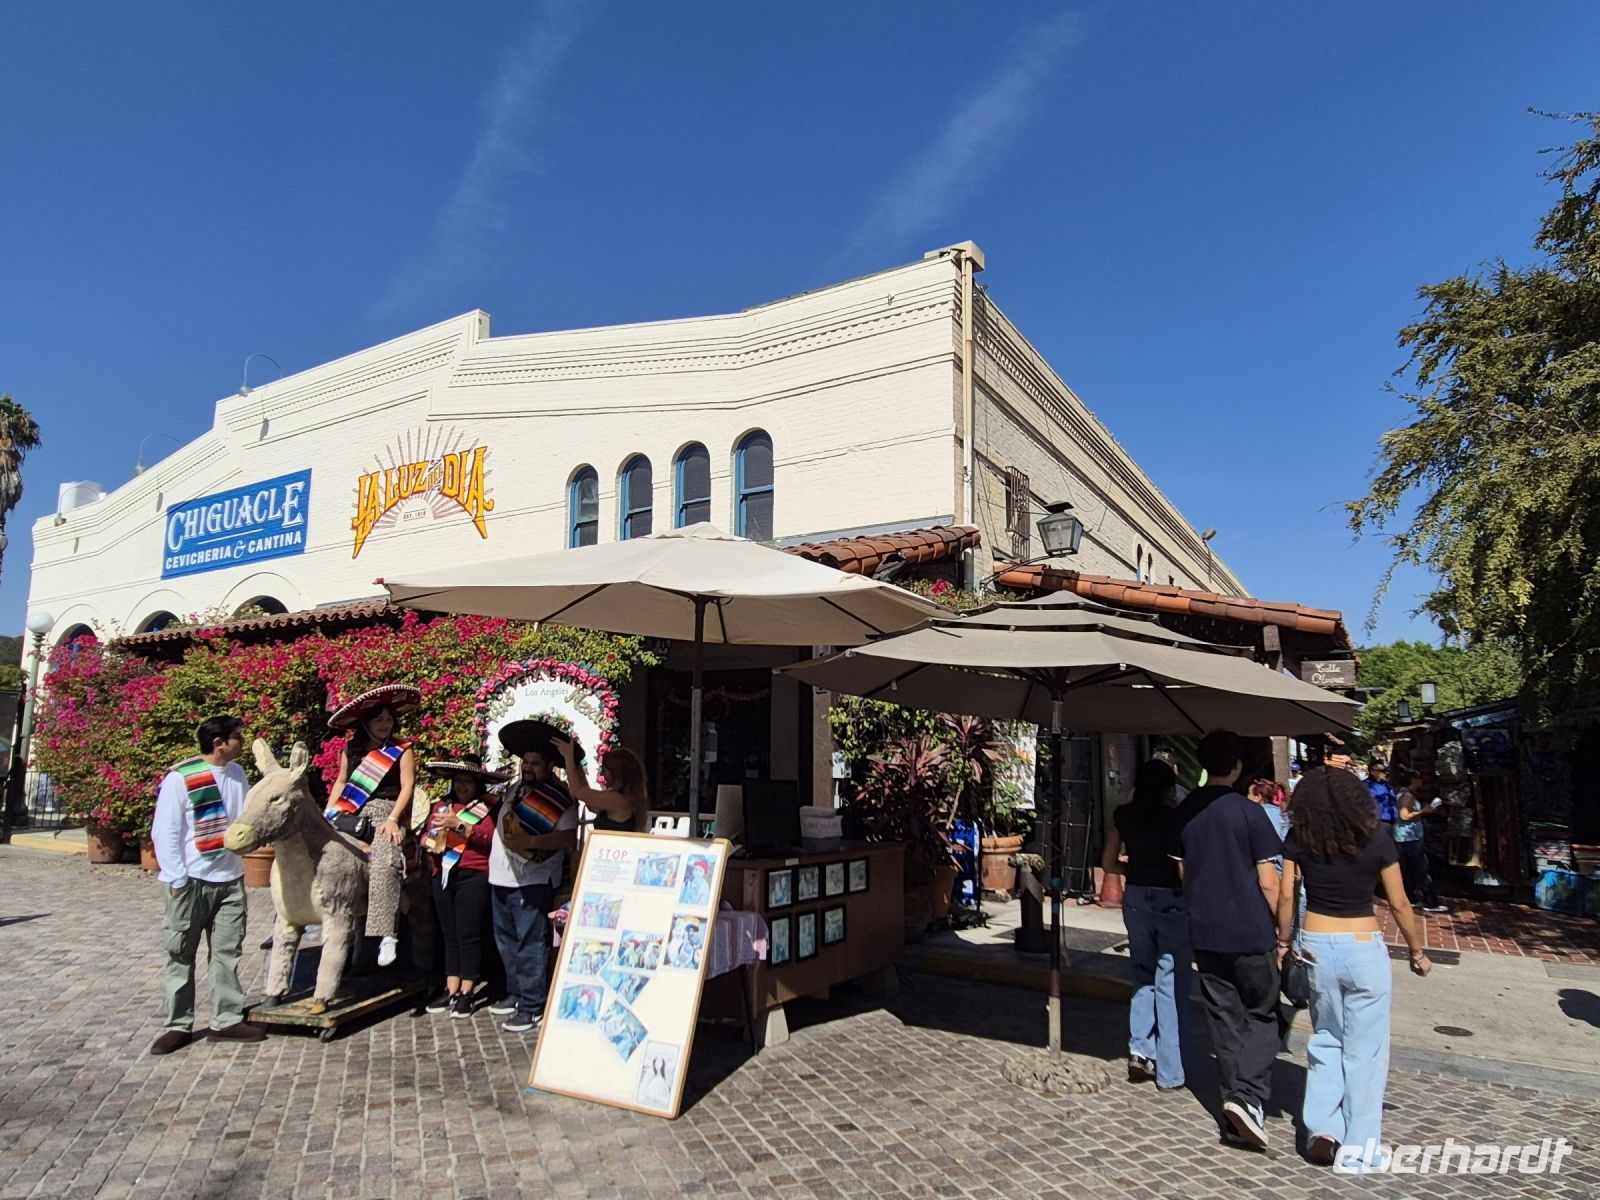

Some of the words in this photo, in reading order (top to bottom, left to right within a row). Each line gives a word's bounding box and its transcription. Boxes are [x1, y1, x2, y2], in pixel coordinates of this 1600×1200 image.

[167, 481, 305, 553] CHIGUACLE
[351, 470, 381, 559] LA
[384, 460, 430, 512] LUZ
[440, 445, 495, 539] DIA
[165, 545, 232, 570] CEVICHERIA
[233, 540, 247, 559] &
[247, 530, 302, 553] CANTINA
[524, 687, 538, 697] Los
[540, 686, 569, 698] Angeles
[598, 848, 629, 860] STOP
